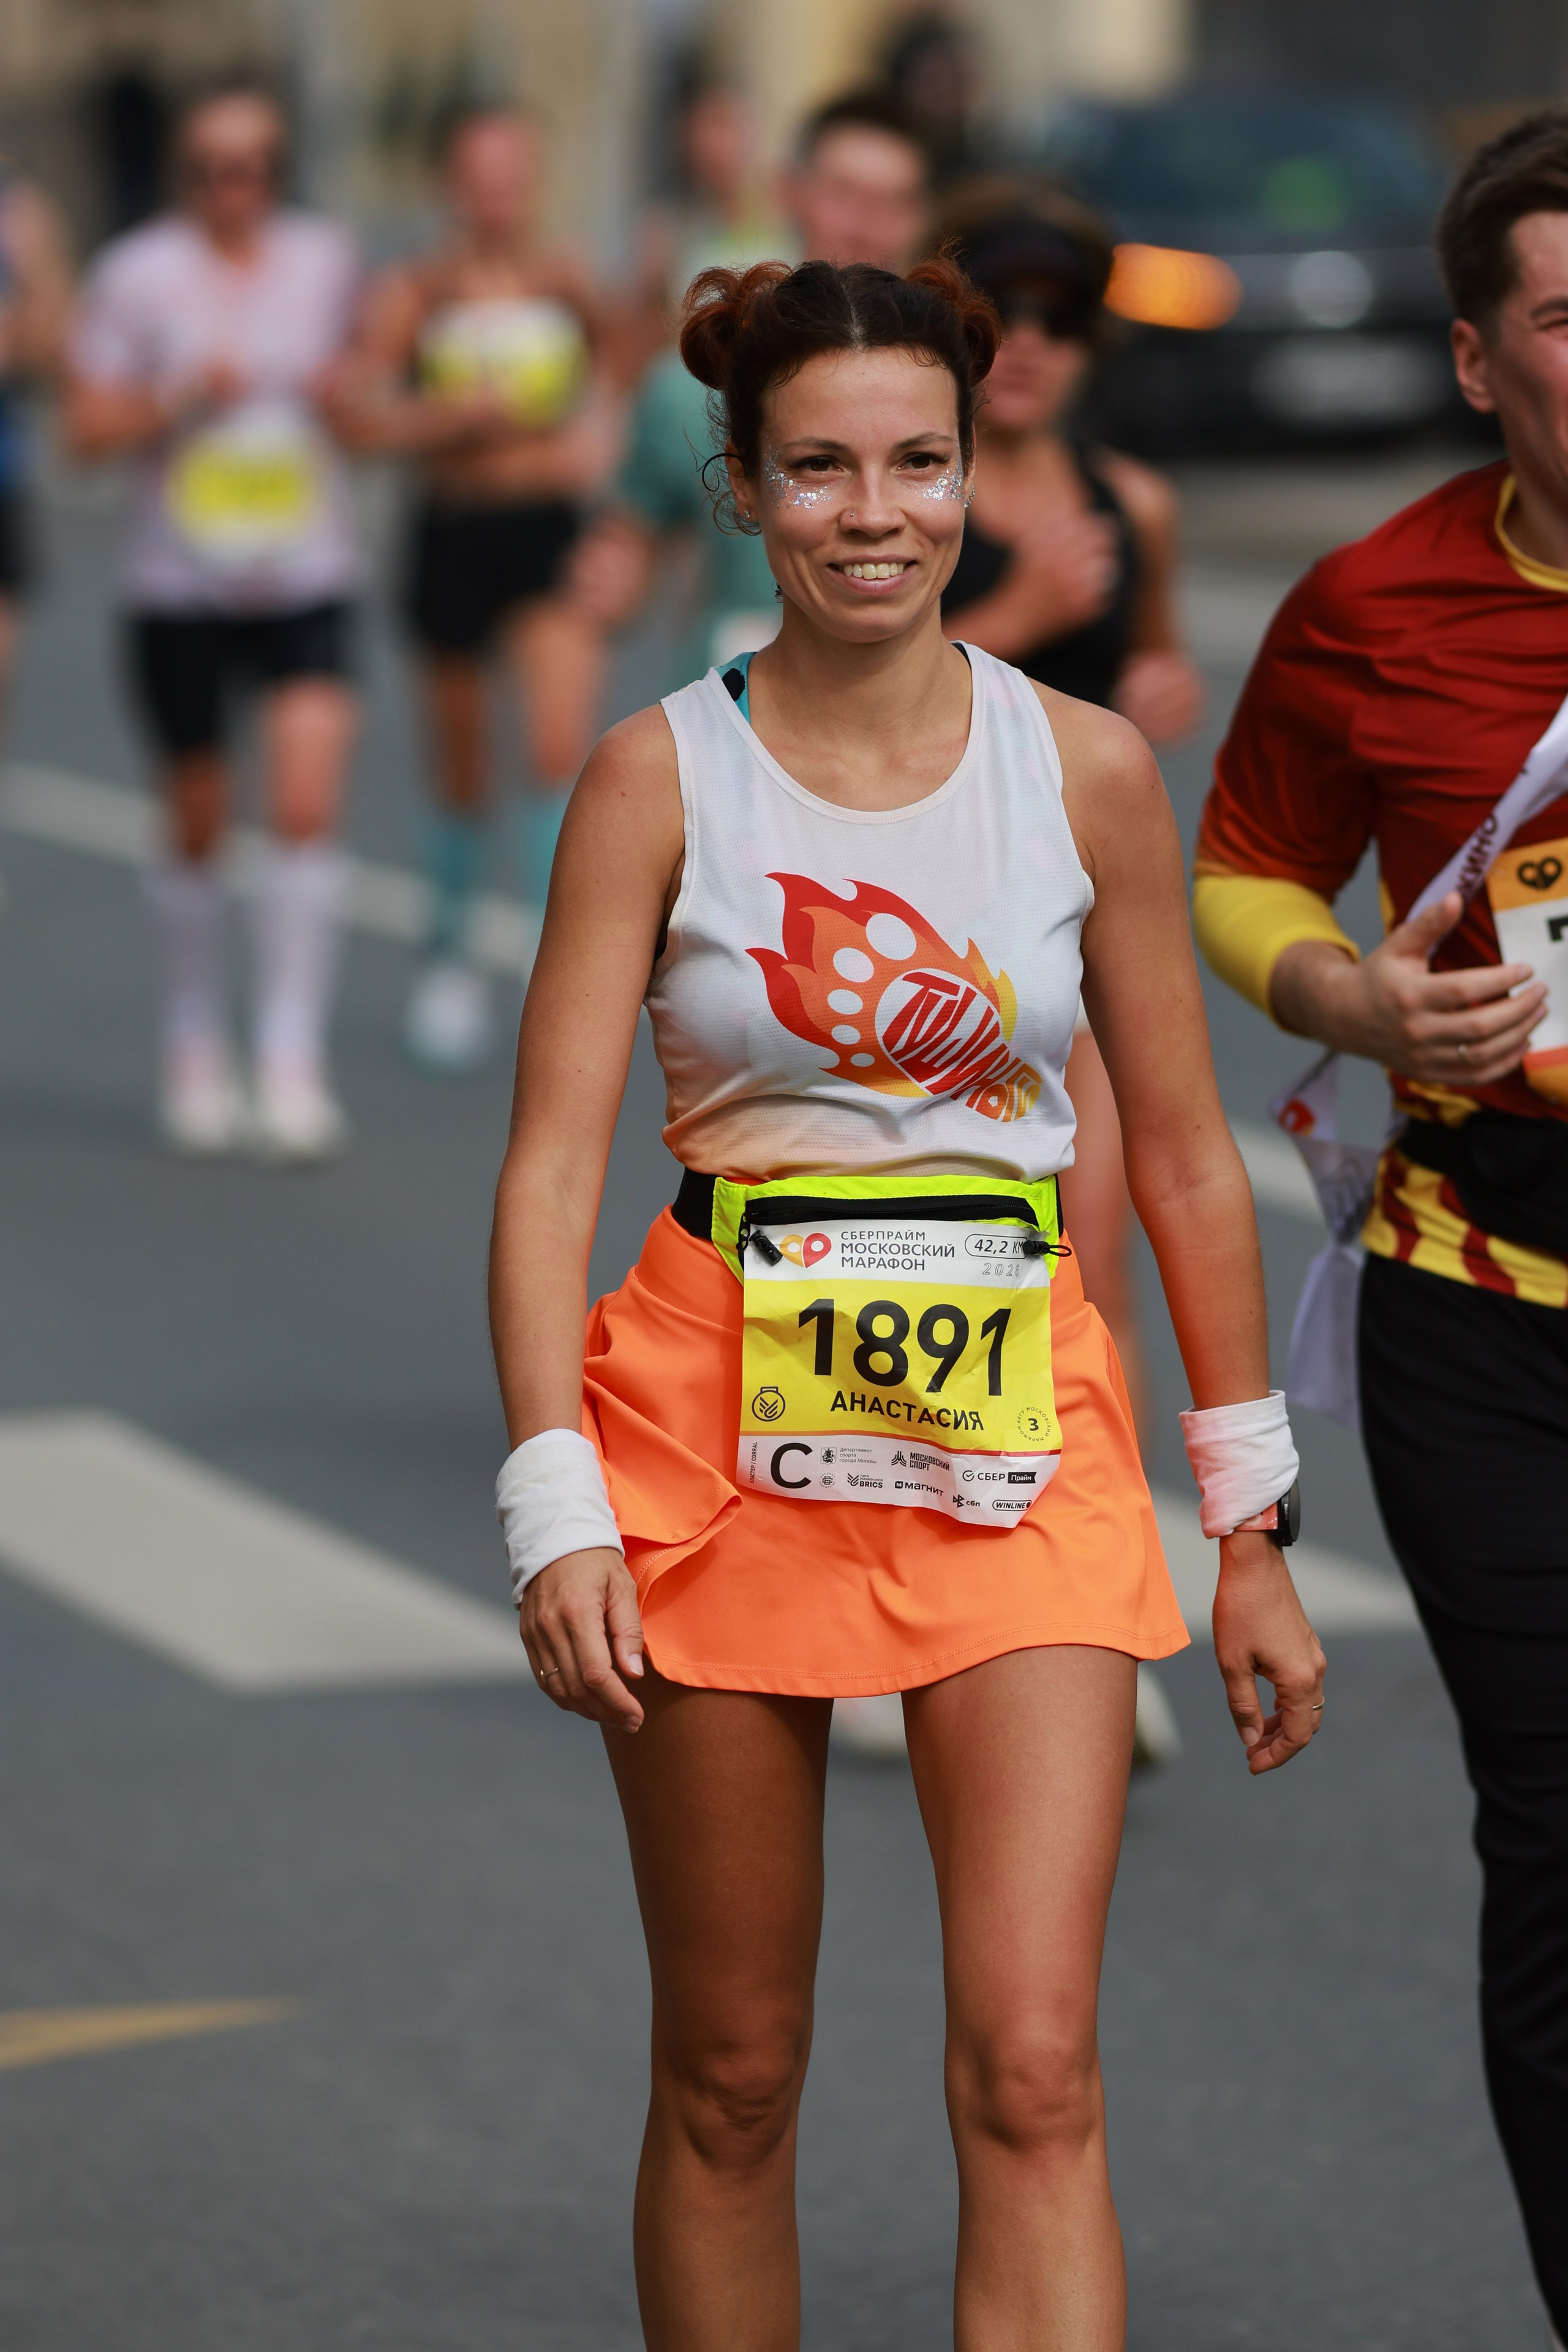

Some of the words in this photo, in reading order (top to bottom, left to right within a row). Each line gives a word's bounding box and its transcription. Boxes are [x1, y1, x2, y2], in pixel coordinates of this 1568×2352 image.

[840, 1229, 925, 1241] СБЕРПРАЙМ
[841, 1243, 955, 1257] МОСКОВСКИЙ
[974, 1239, 1008, 1254] 42,2
[841, 1256, 925, 1271] МАРАФОН
[982, 1262, 1020, 1277] 2026
[798, 1298, 1012, 1396] 1891
[830, 1390, 984, 1431] АНАСТАСИЯ
[1026, 1406, 1051, 1437] МОСКОВСКИЙ
[1028, 1417, 1039, 1431] 3
[1017, 1426, 1044, 1442] МАРАФОН
[910, 1452, 950, 1471] МОСКОВСКИЙ
[910, 1460, 930, 1471] СПОРТ
[978, 1472, 1005, 1481] СБЕР
